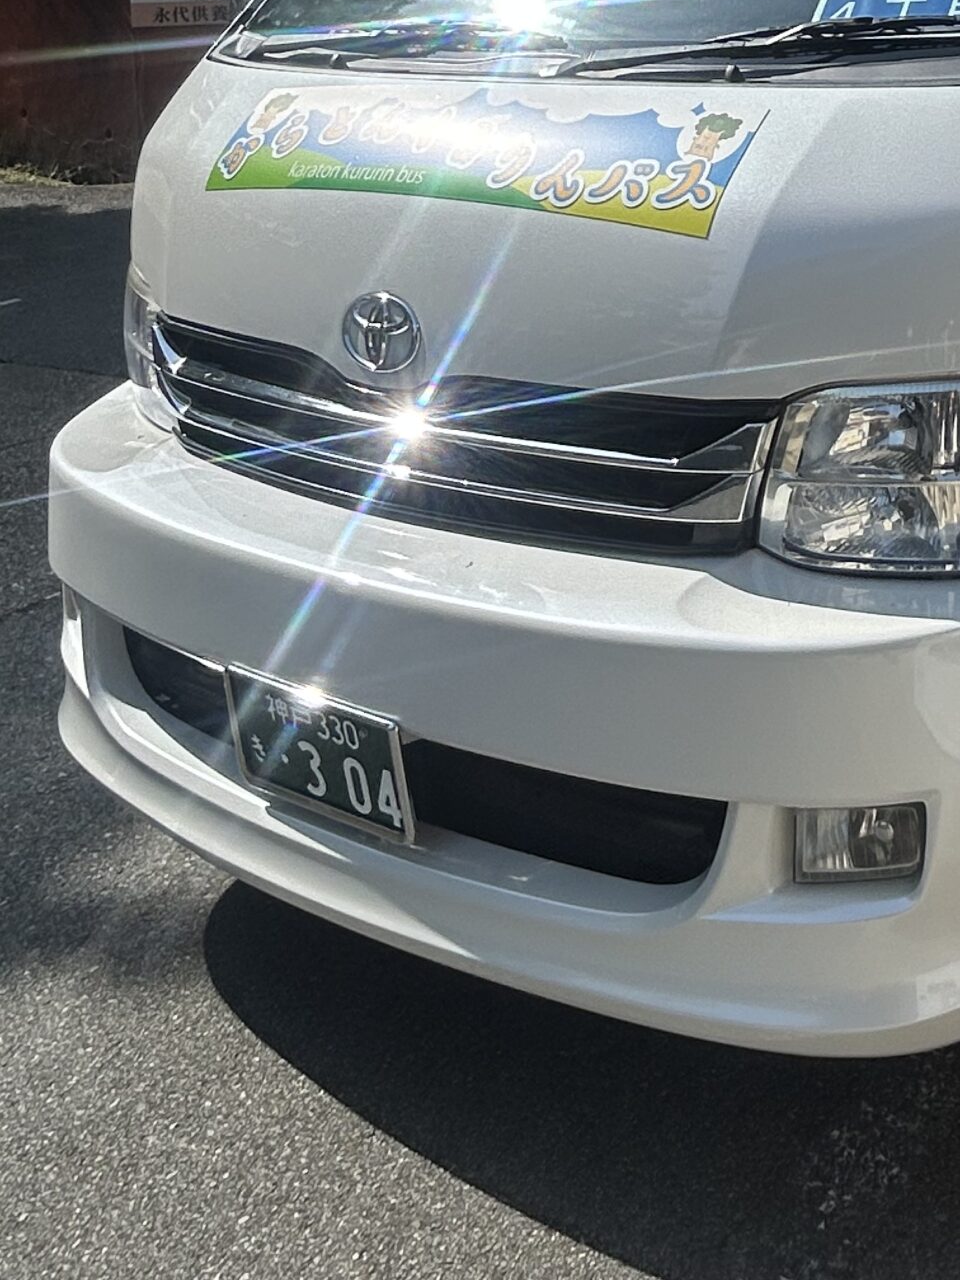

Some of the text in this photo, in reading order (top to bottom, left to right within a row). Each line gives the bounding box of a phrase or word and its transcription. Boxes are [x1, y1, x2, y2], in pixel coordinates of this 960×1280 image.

[288, 160, 426, 184] karaton kururin bus
[317, 711, 360, 750] 330
